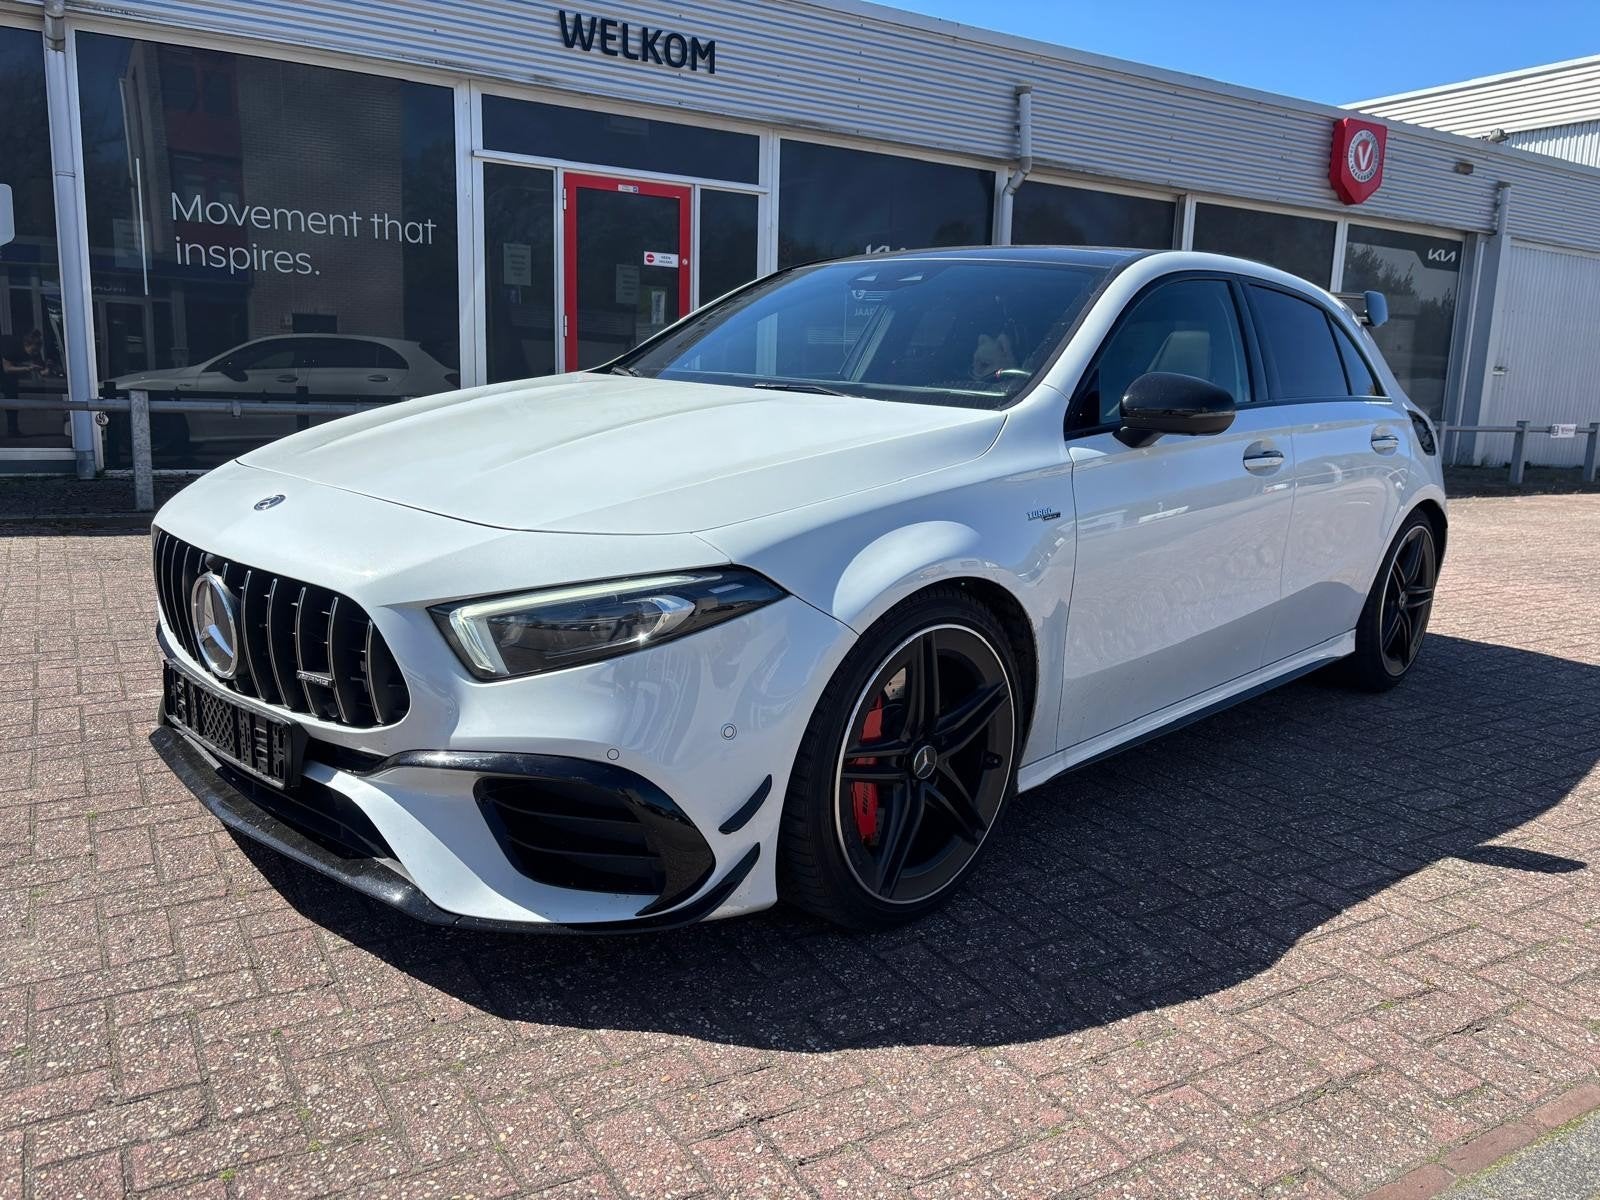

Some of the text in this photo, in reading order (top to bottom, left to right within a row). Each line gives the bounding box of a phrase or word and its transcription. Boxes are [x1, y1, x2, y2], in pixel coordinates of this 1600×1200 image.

[559, 10, 716, 75] WELKOM
[171, 191, 437, 245] Movement that
[175, 236, 320, 275] inspires.
[1428, 248, 1456, 262] KIA
[1026, 507, 1053, 520] TURBO
